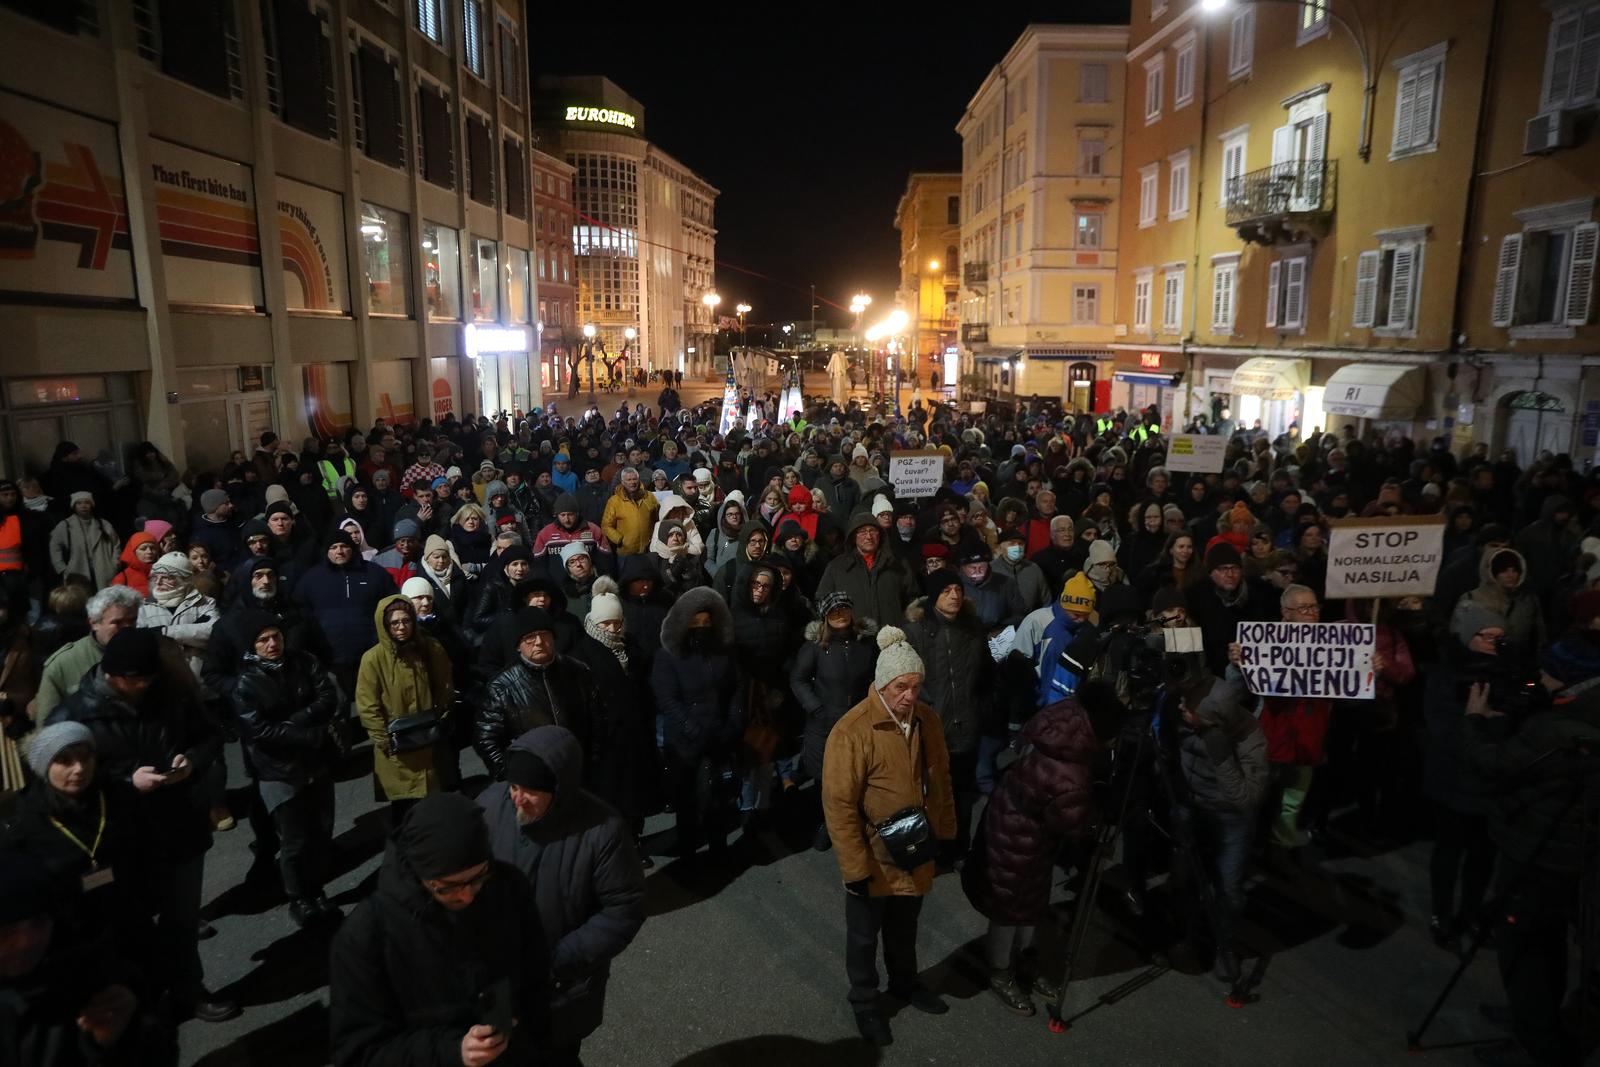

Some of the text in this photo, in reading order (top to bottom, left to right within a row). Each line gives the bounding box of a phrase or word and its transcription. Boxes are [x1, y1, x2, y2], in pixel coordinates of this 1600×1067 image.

[565, 106, 635, 129] EUROHERC
[152, 164, 247, 202] That first bite has
[1345, 387, 1361, 400] RI
[901, 487, 938, 495] galebove?
[1355, 531, 1419, 548] STOP
[1334, 553, 1437, 567] NORMALIZACIJI
[1344, 569, 1420, 585] NASILJA
[1239, 624, 1373, 646] KORUMPIRANOJ
[1240, 646, 1355, 668] RI-POLICIJI
[1243, 667, 1361, 697] KAZNENU
